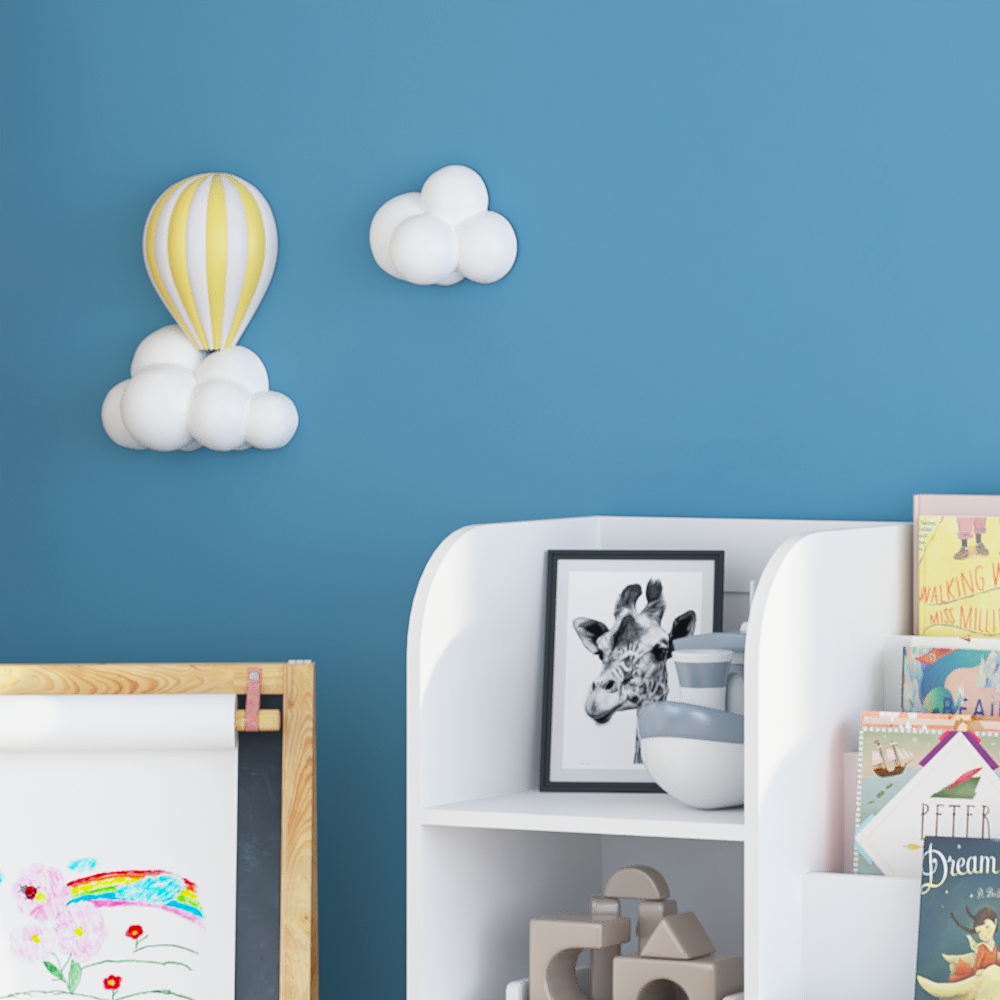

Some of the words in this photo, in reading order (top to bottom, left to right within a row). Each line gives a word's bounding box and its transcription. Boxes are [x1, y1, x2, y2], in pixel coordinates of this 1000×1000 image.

[920, 564, 985, 603] WALKING
[929, 607, 955, 625] MISS
[921, 802, 991, 840] PETER
[921, 842, 1000, 895] Dream
